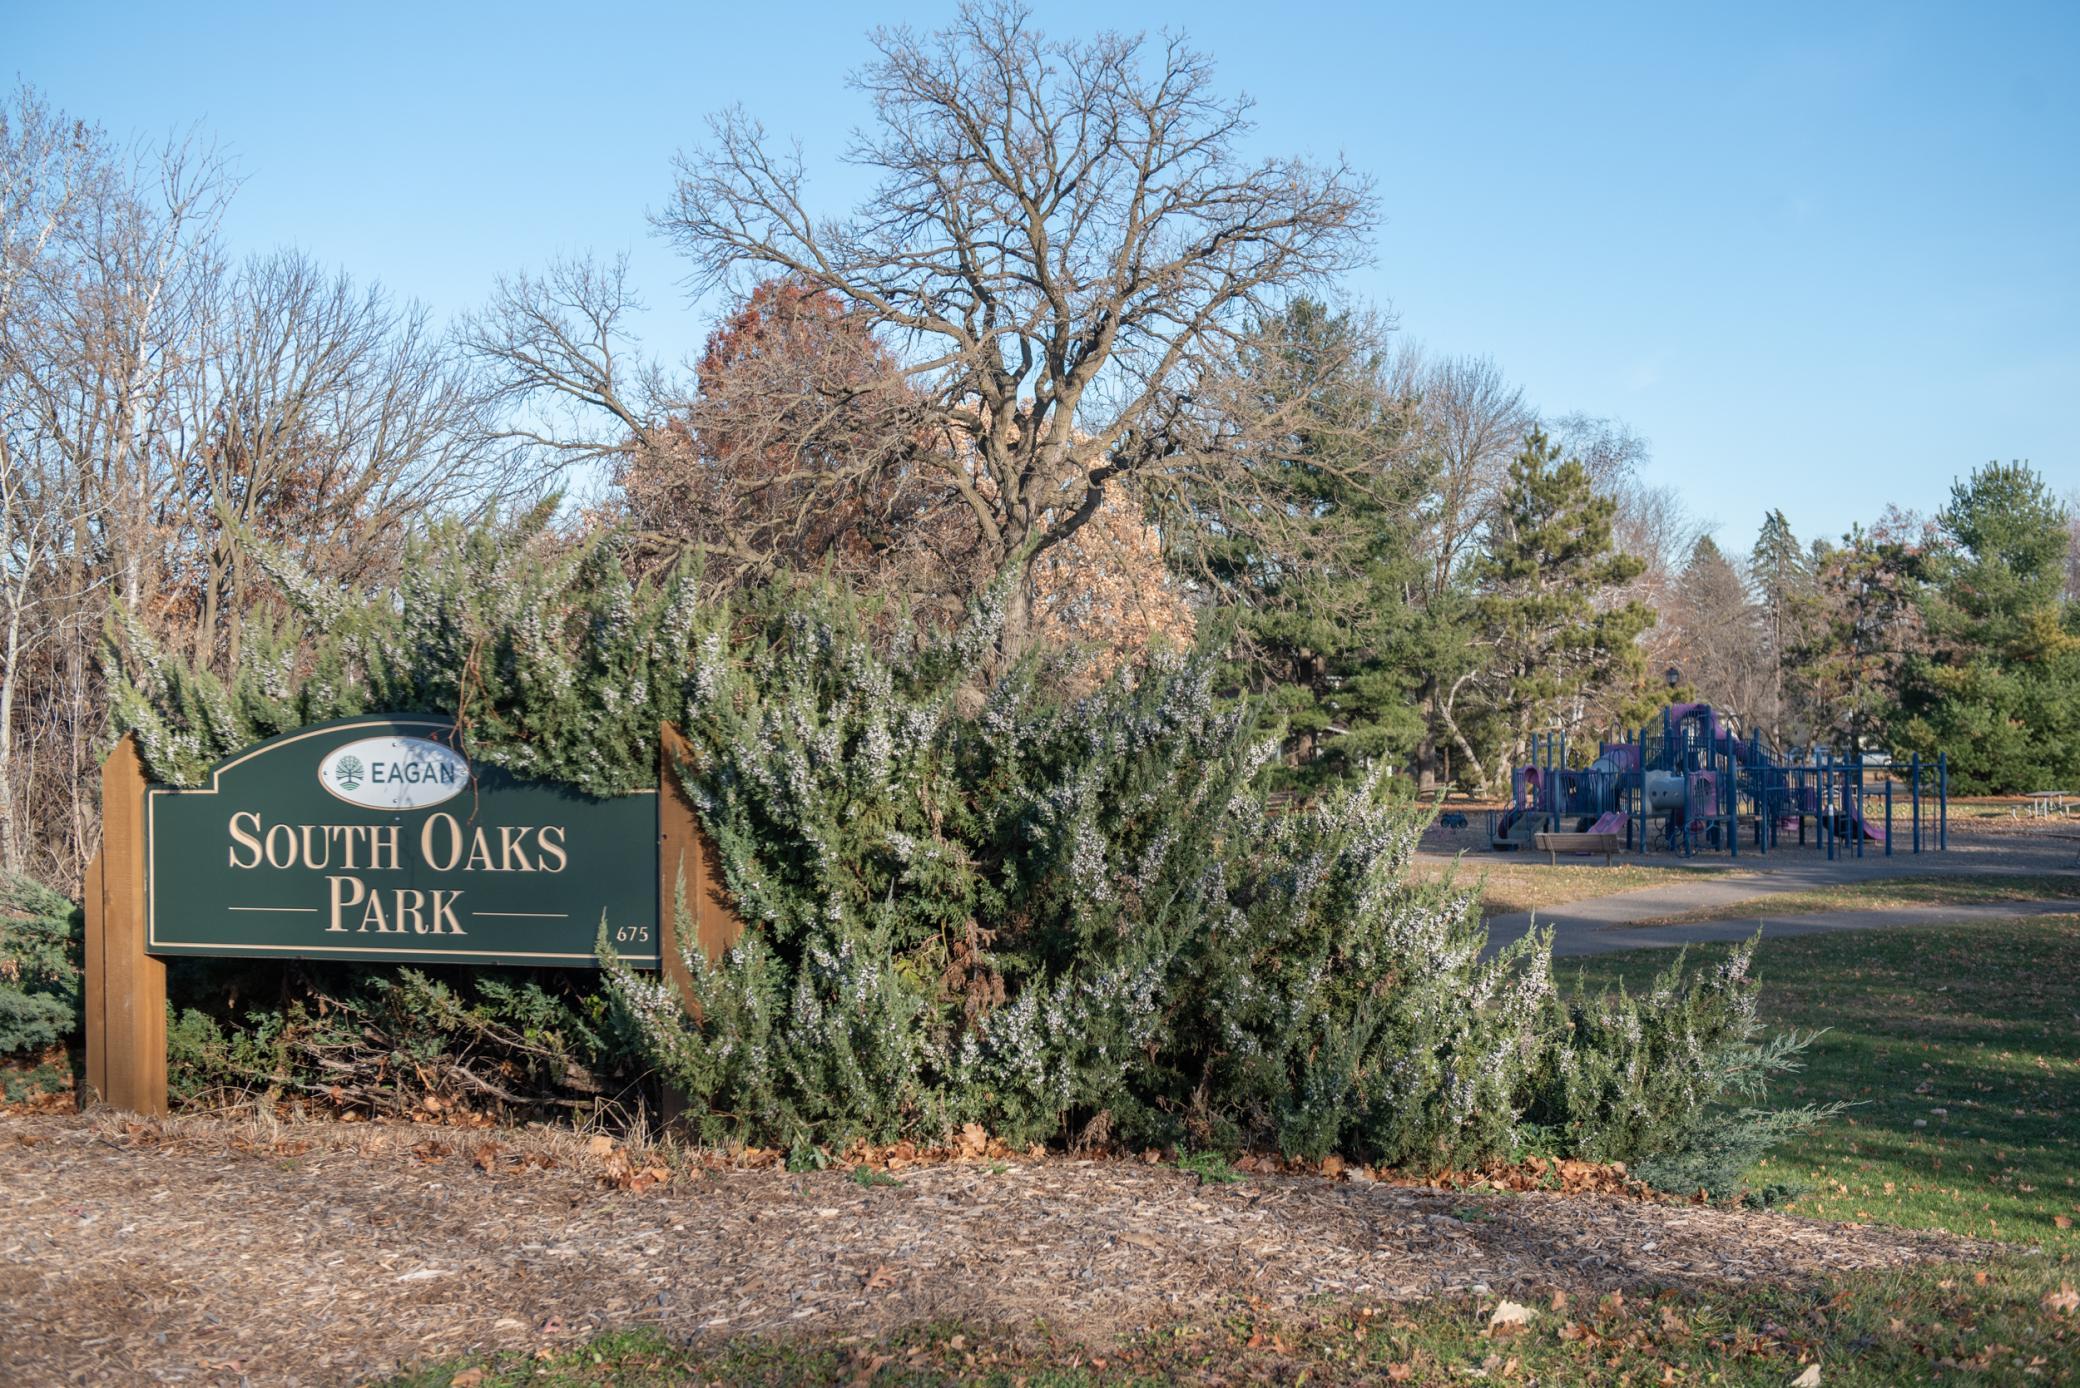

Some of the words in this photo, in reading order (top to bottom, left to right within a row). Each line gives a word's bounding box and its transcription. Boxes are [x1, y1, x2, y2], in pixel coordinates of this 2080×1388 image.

[371, 761, 455, 784] EAGAN
[228, 811, 402, 871] SOUTH
[420, 812, 567, 873] OAKS
[324, 875, 468, 935] PARK
[616, 926, 649, 943] 675
